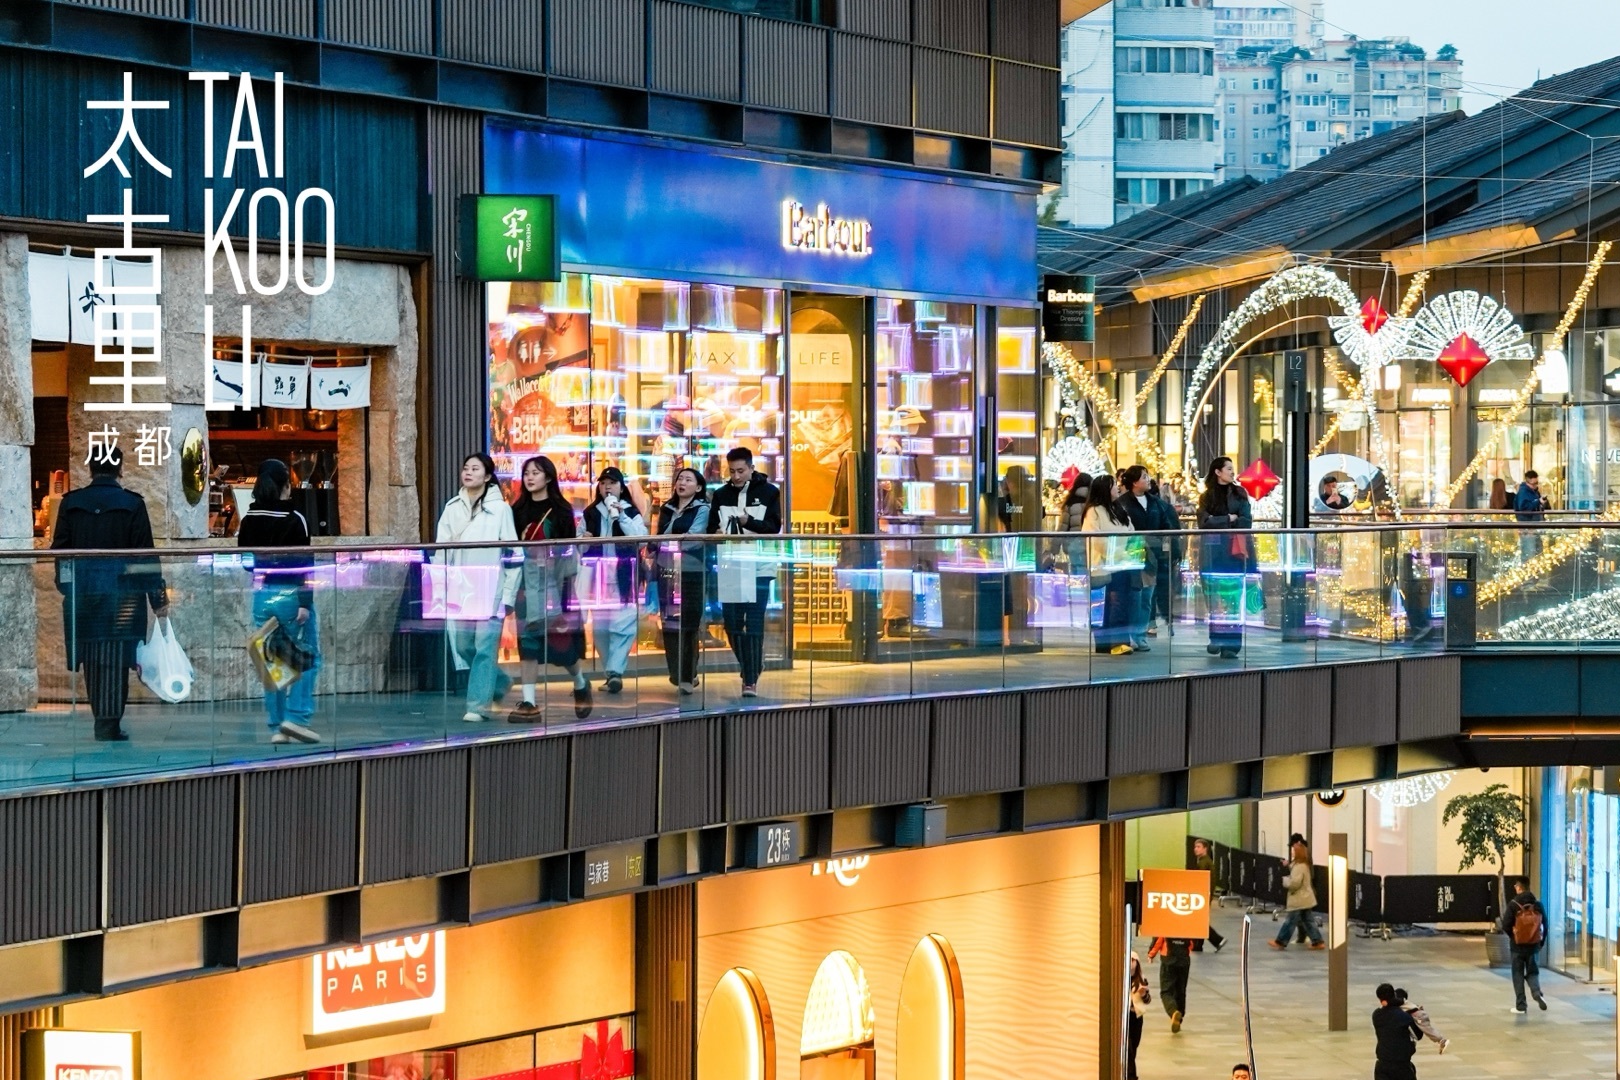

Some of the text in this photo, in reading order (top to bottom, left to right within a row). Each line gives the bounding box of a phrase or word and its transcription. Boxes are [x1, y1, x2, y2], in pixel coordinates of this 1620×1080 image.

[1047, 288, 1095, 302] Barbour
[799, 351, 840, 365] LIFE
[1289, 355, 1302, 370] L2
[767, 827, 781, 864] 23
[588, 855, 642, 885] 马家巷 东区
[1147, 892, 1206, 915] FRED
[327, 964, 427, 997] PARIS
